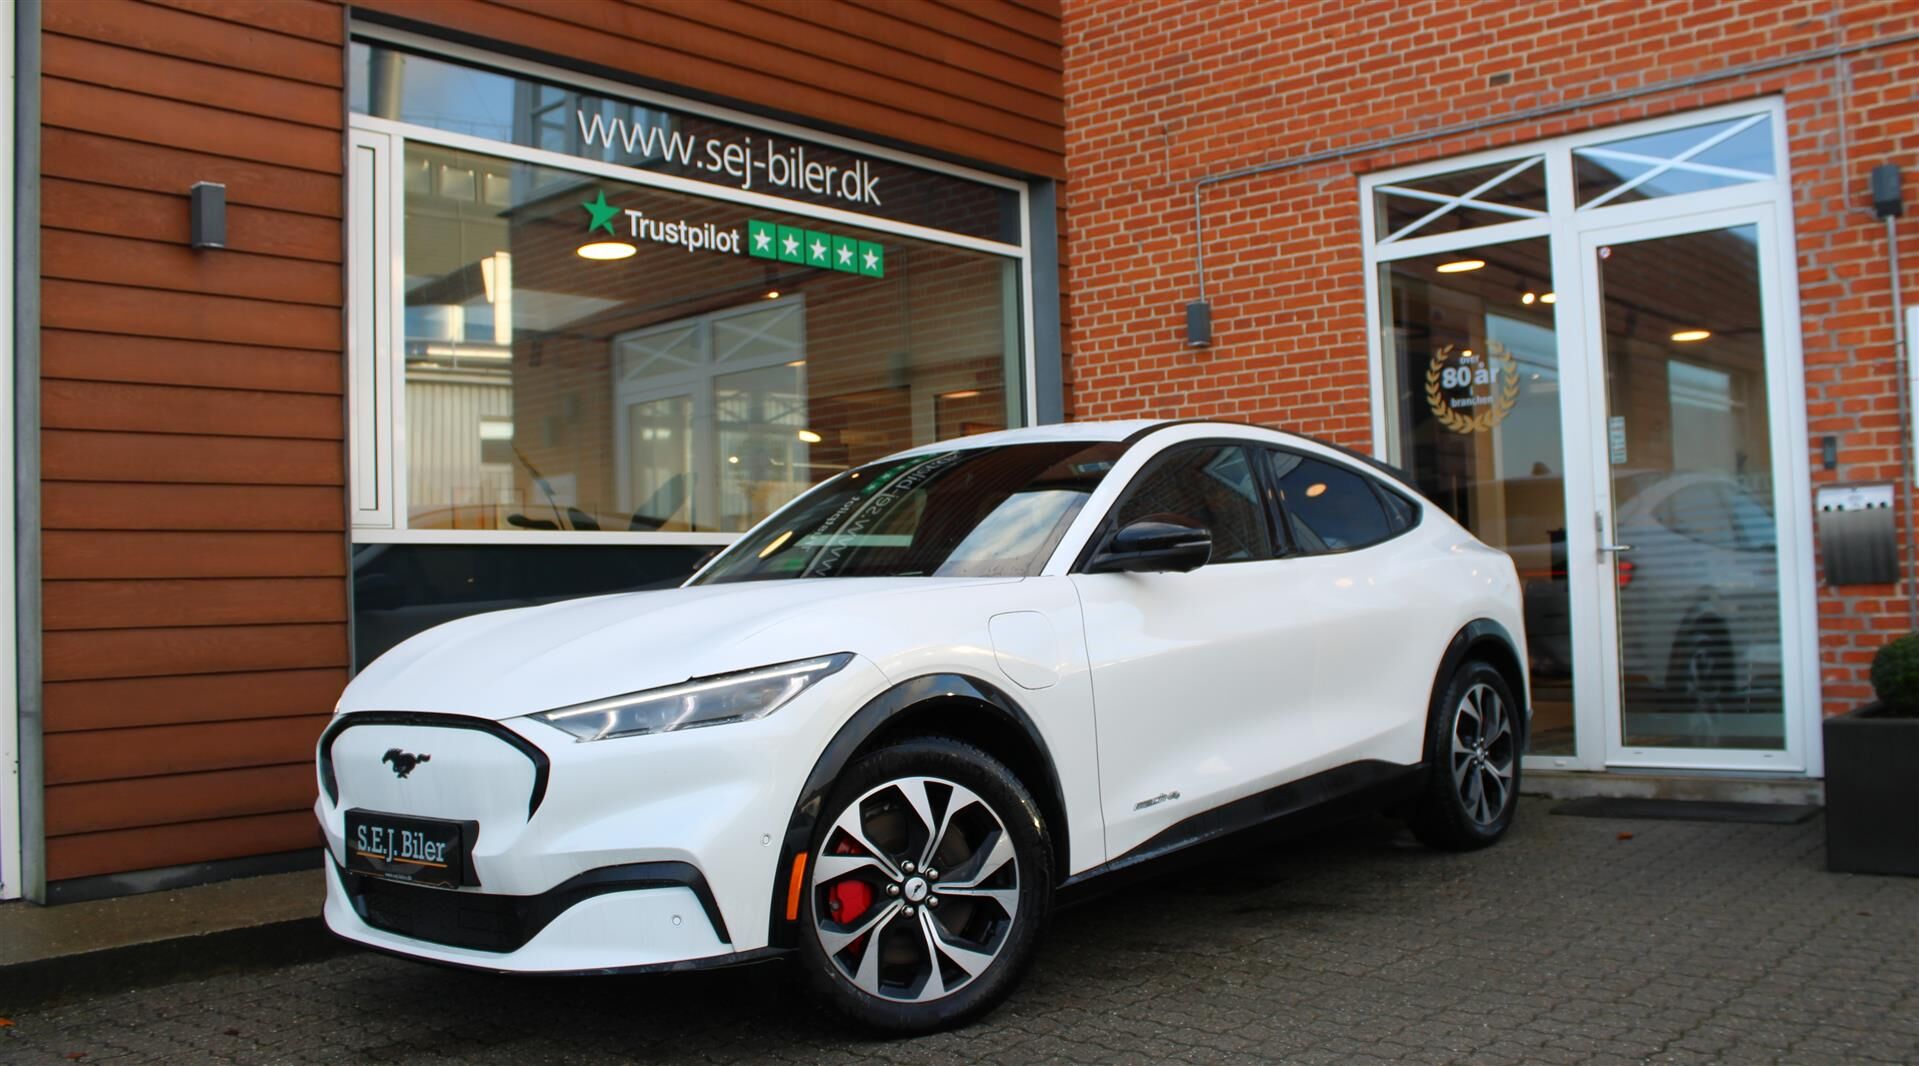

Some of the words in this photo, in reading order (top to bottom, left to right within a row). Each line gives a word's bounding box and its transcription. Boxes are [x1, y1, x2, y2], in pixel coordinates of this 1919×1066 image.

[577, 110, 881, 205] www.sej-biler.dk
[624, 208, 740, 254] Trustpilot
[1442, 366, 1471, 389] 80
[1475, 361, 1498, 384] år
[1451, 396, 1493, 408] branchen
[357, 824, 398, 863] S.E.J.
[401, 830, 446, 862] Biler
